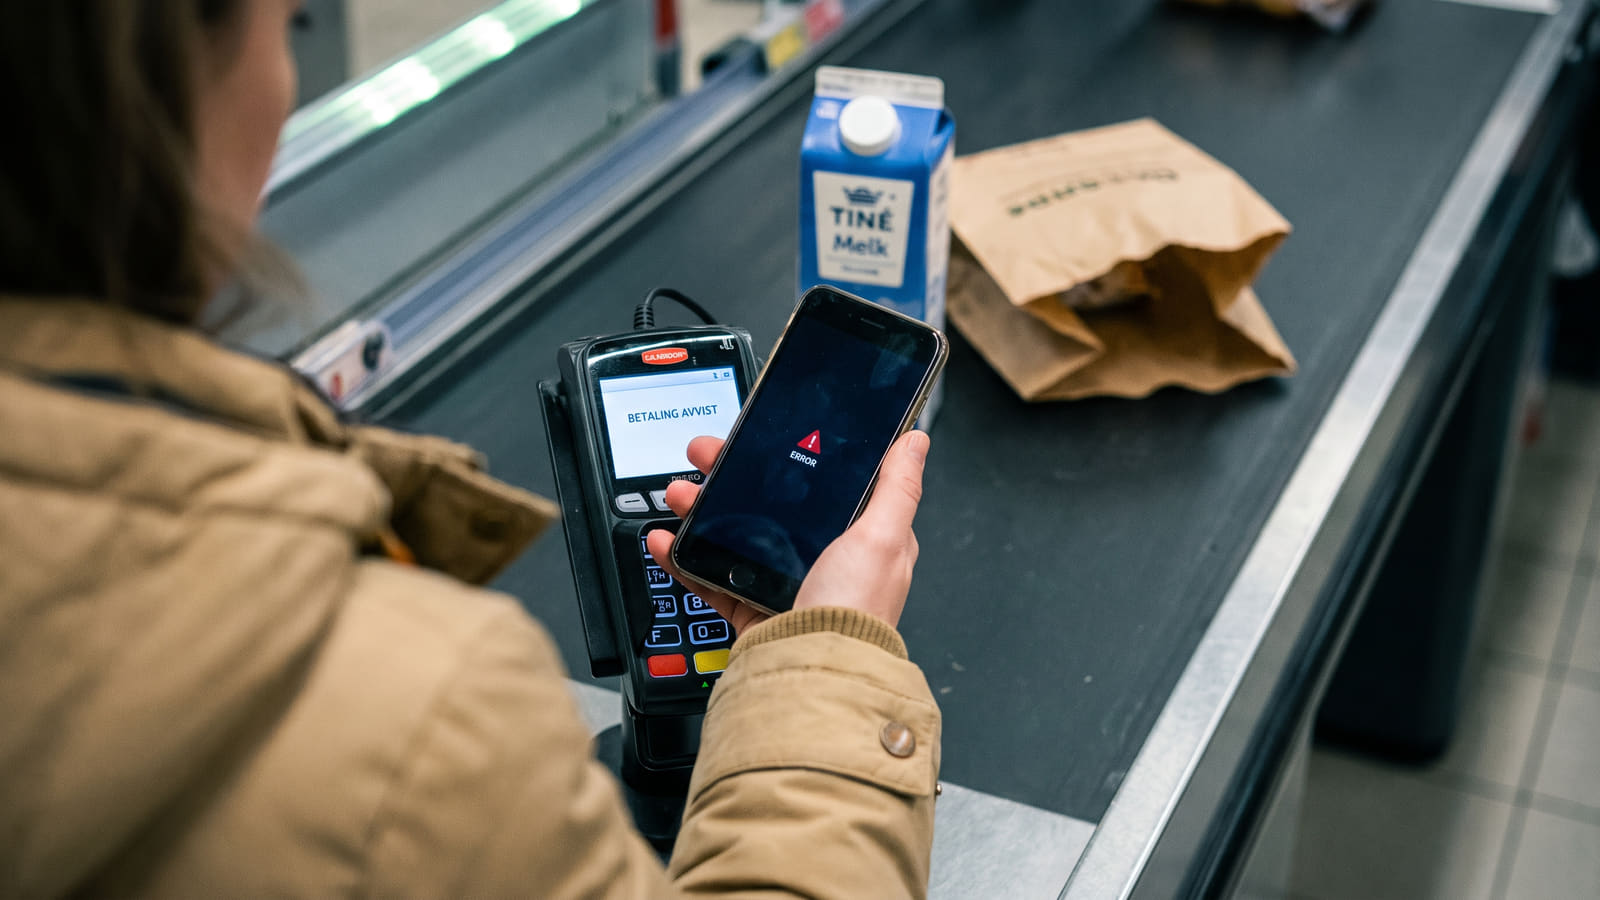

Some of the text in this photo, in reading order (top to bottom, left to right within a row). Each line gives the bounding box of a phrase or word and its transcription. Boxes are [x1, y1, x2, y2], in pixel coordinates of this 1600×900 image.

[627, 404, 718, 423] BETALING AVVIST
[790, 450, 817, 467] ERROR
